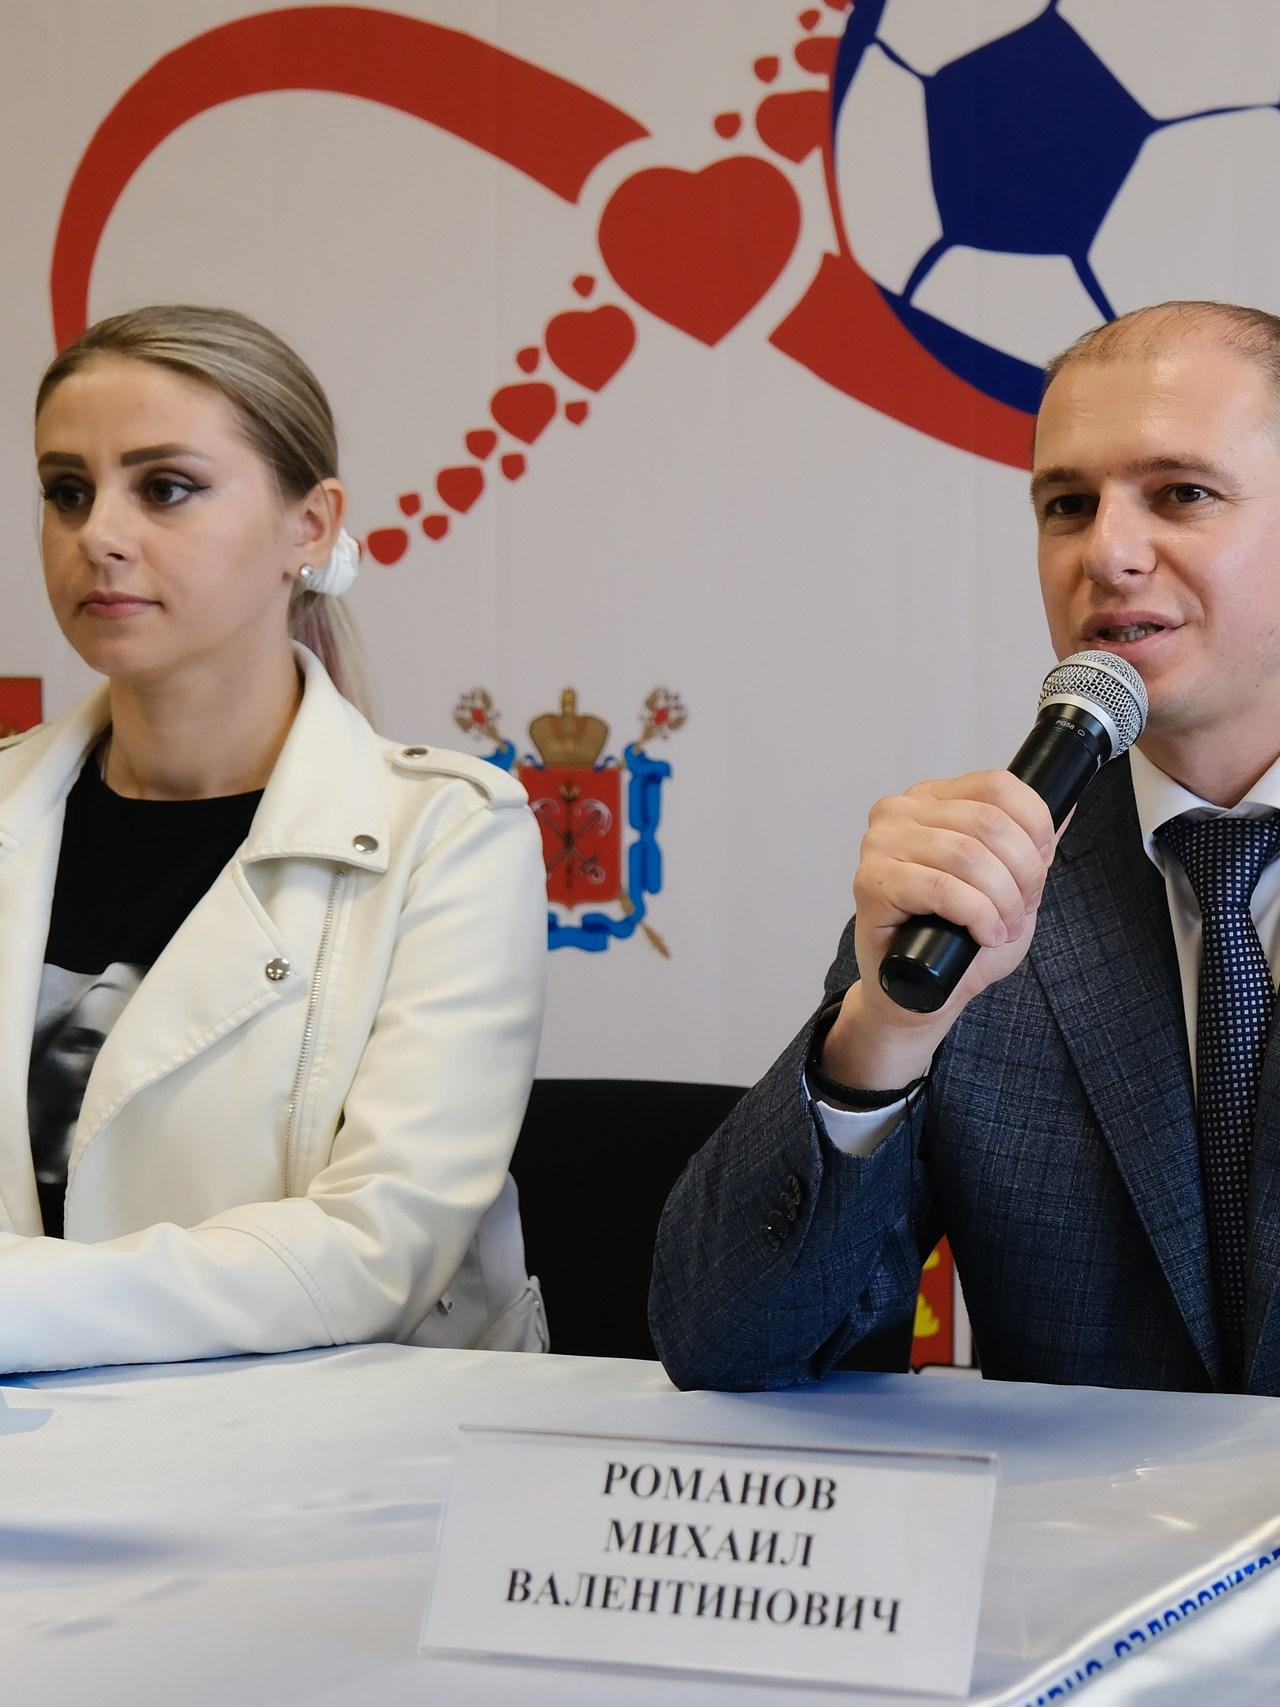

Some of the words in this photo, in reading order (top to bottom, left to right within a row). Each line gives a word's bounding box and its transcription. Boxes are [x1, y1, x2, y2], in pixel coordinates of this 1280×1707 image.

[601, 1460, 839, 1512] РОМАНОВ
[603, 1518, 816, 1568] МИХАИЛ
[505, 1567, 901, 1634] ВАЛЕНТИНОВИЧ
